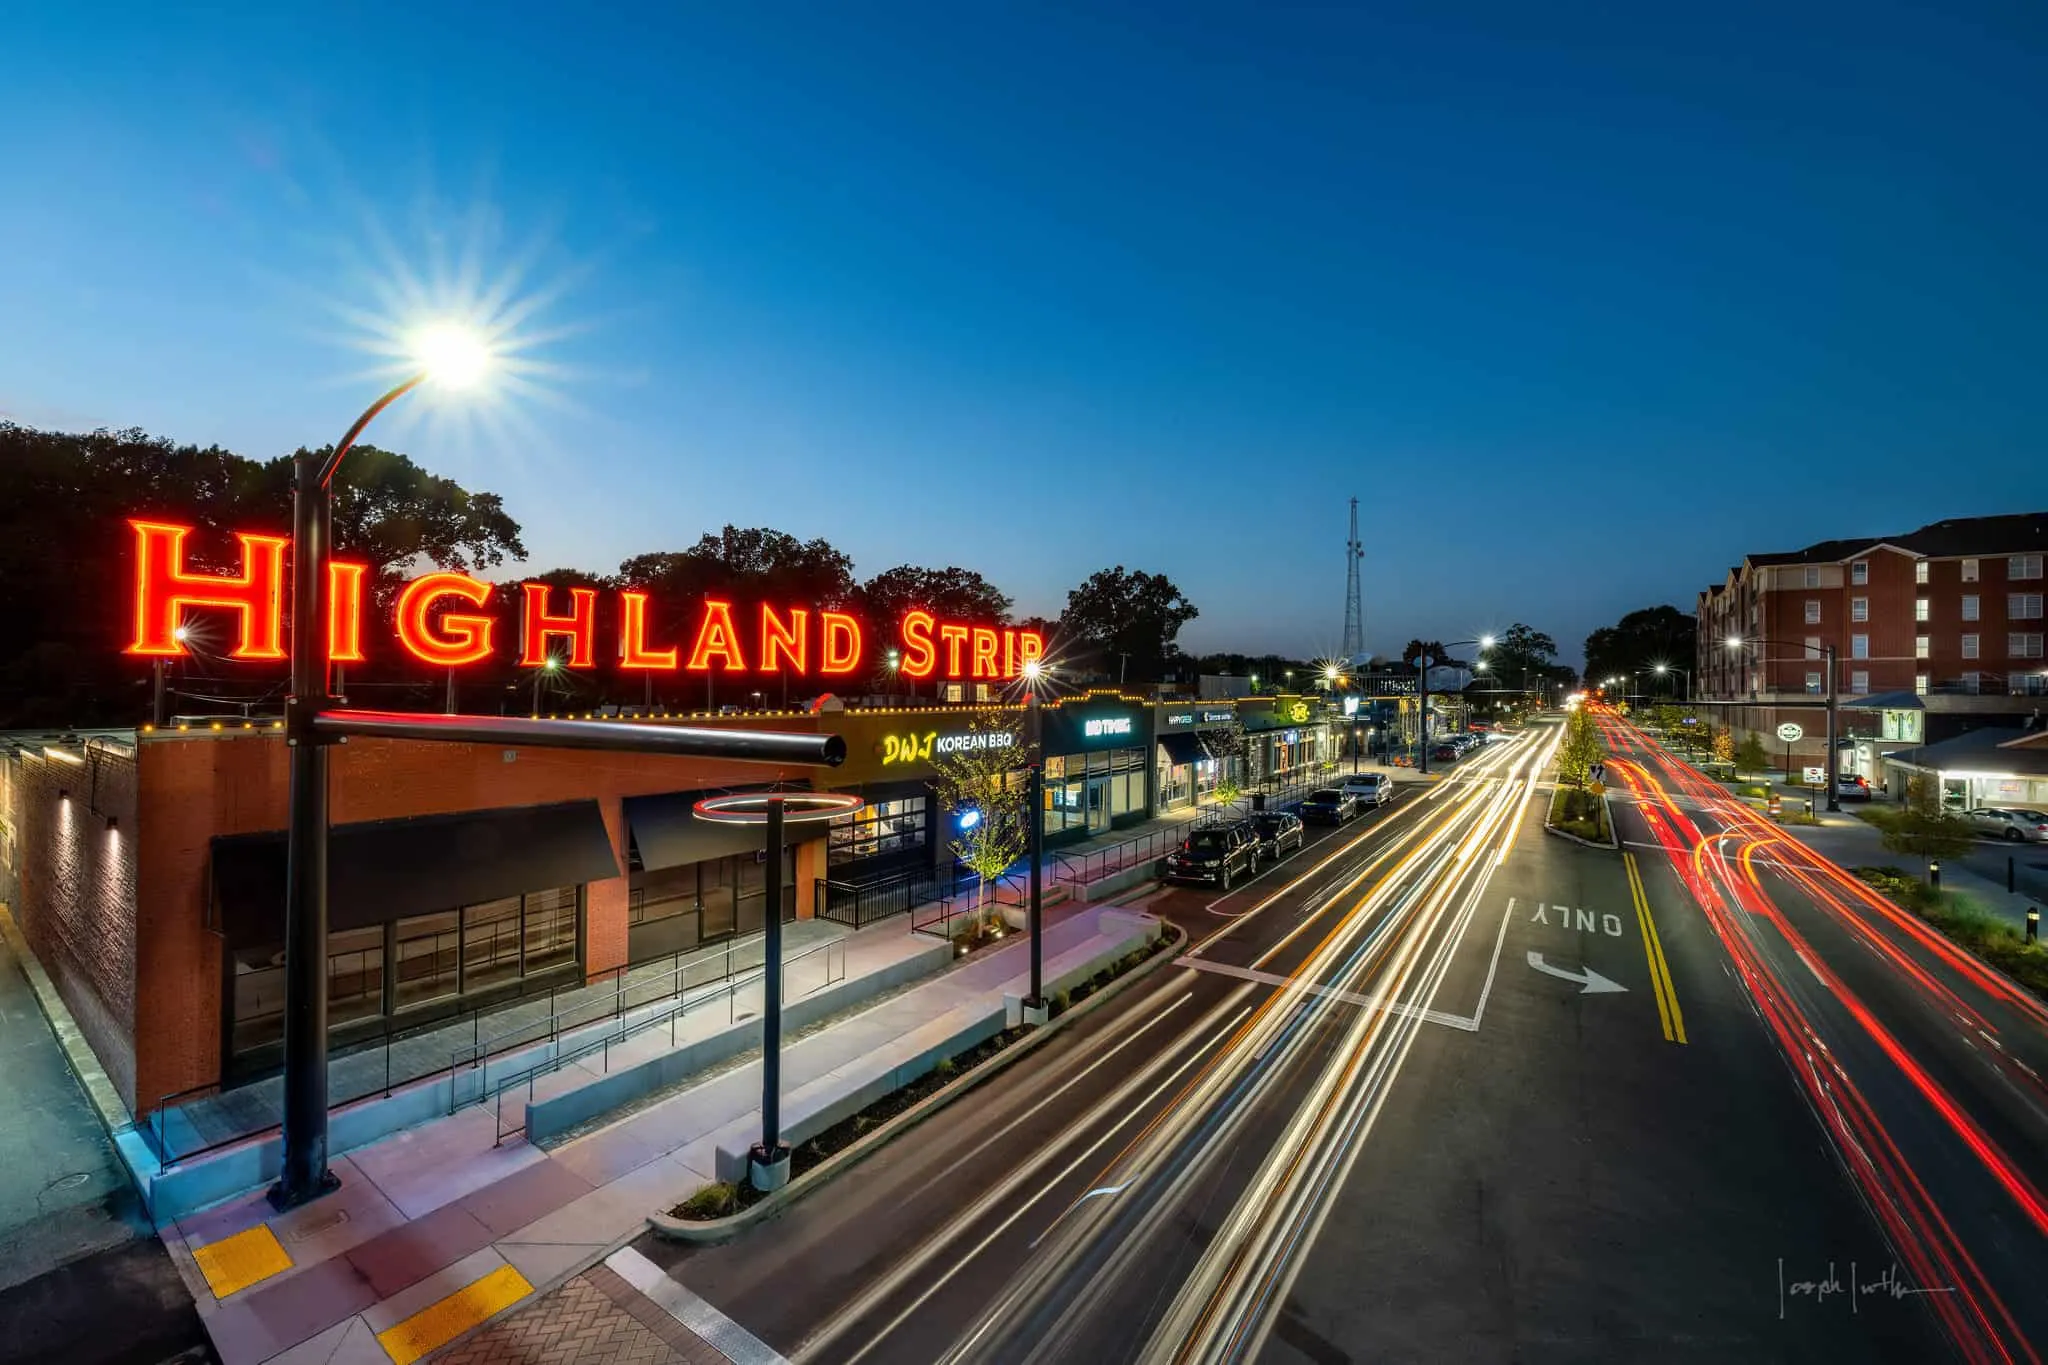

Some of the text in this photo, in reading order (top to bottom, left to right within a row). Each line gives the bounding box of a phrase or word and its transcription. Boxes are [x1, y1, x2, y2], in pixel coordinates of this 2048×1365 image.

[901, 610, 1044, 678] STRIP
[936, 734, 987, 753] KOREAN
[988, 732, 1012, 748] BBQ
[1530, 903, 1623, 937] ONLY
